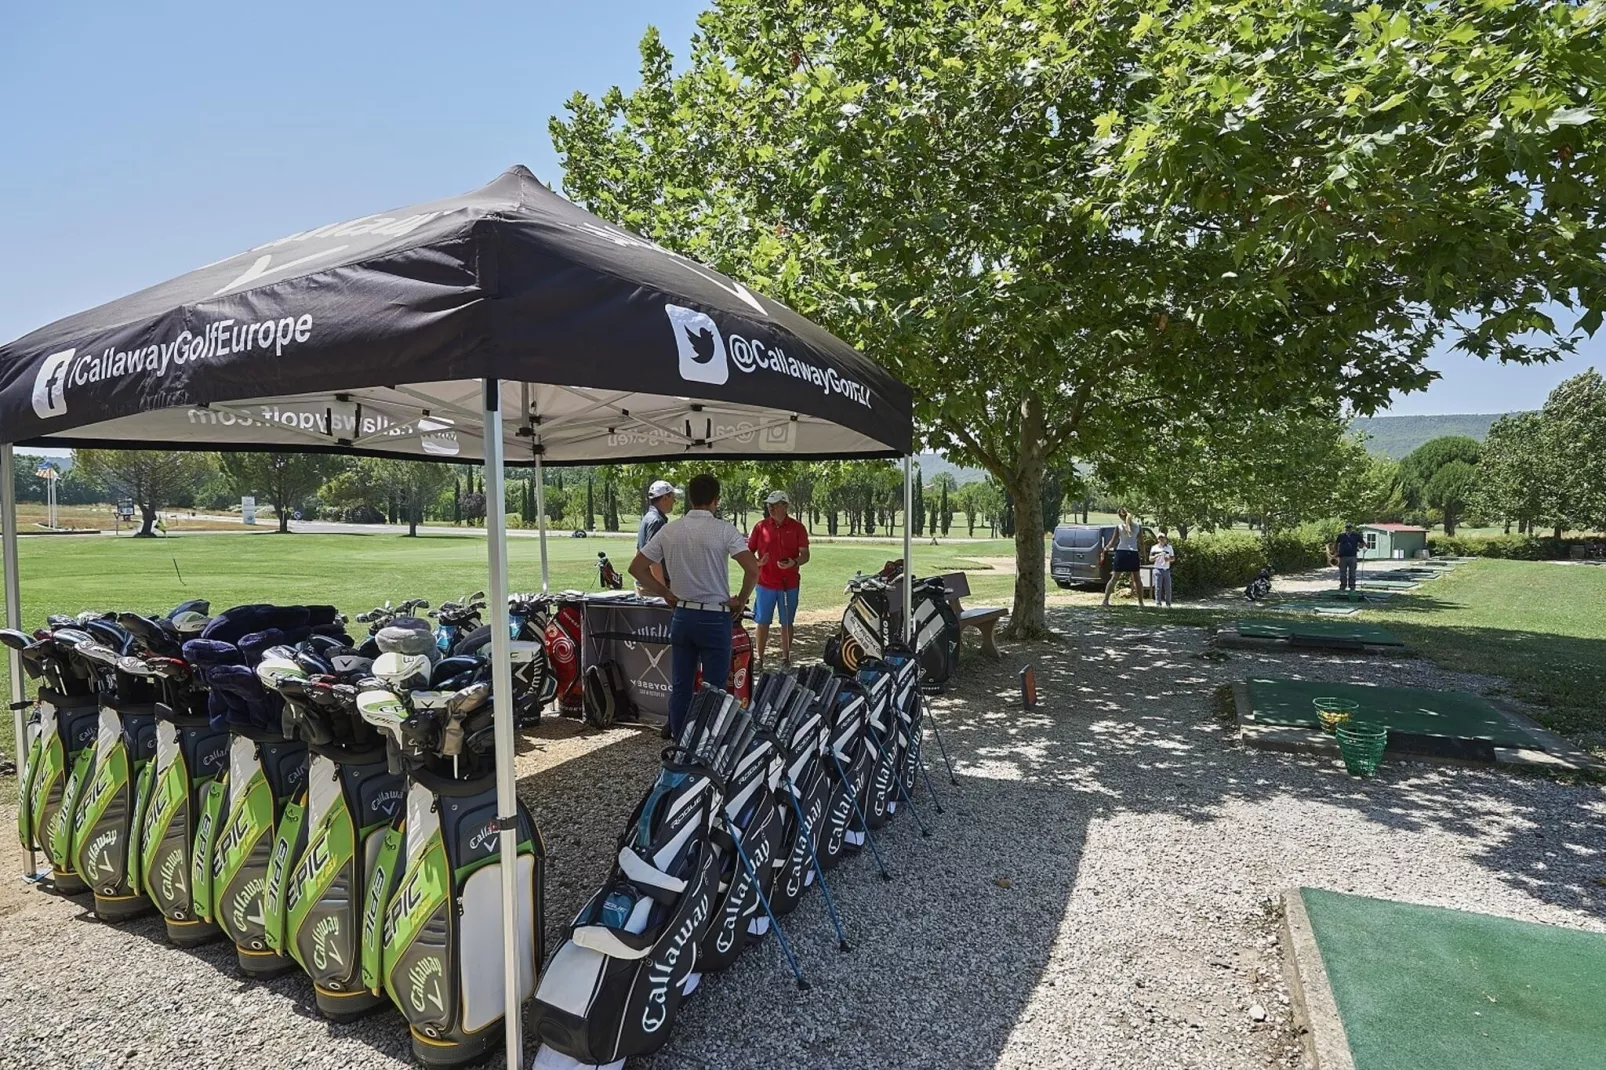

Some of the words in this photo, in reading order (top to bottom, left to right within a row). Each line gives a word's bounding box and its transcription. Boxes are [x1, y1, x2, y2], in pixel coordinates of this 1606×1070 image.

[74, 768, 108, 834] EPIC
[669, 797, 702, 830] ROGUE
[86, 828, 118, 882] Callaway
[160, 848, 185, 901] Callaway
[191, 813, 213, 885] EPIC
[211, 809, 250, 879] EPIC
[264, 837, 289, 917] EPIC
[287, 834, 331, 912] EPIC
[312, 915, 340, 970] Callaway
[361, 866, 387, 953] EPIC
[381, 871, 423, 949] EPIC
[409, 955, 443, 1013] Callaway
[642, 893, 709, 1033] Callaway
